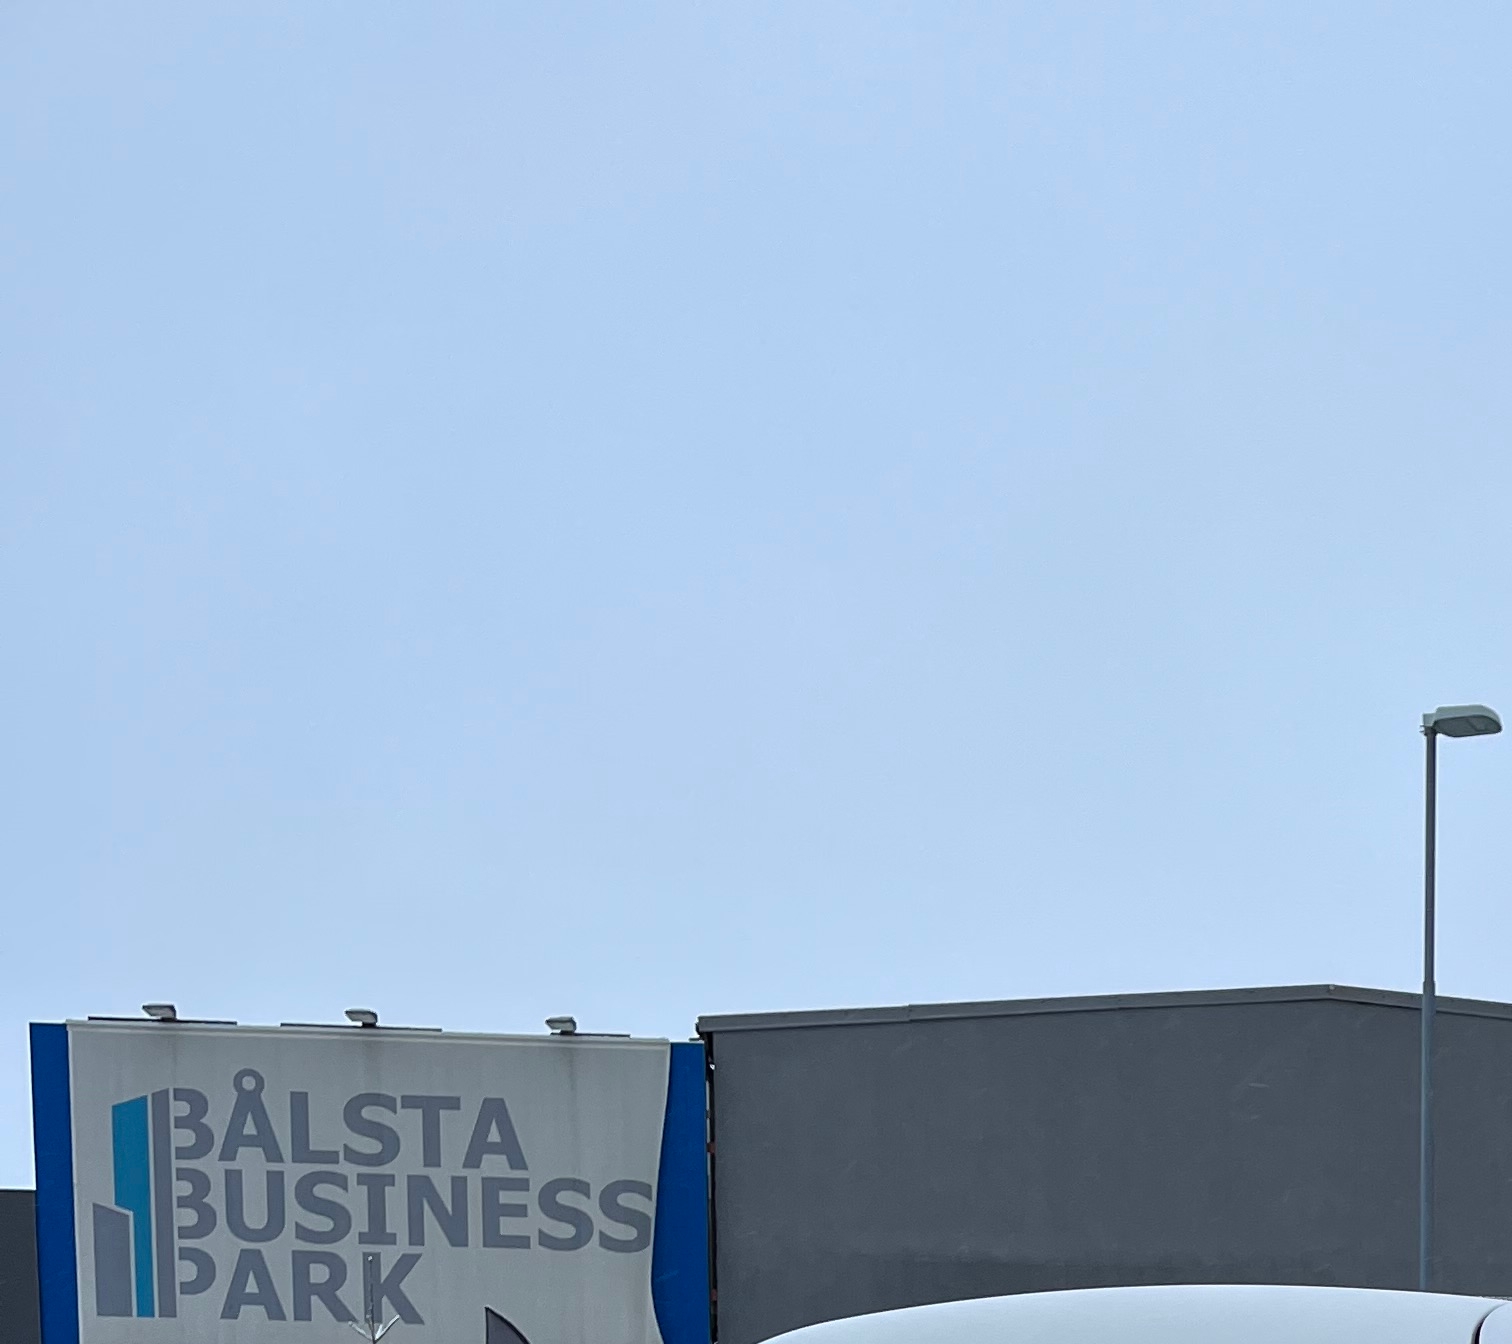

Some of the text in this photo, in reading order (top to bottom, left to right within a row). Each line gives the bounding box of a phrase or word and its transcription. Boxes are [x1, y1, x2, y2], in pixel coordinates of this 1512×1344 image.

[171, 1067, 529, 1171] BÅLSTA
[175, 1168, 653, 1253] BUSINESS
[178, 1247, 424, 1325] PARK
